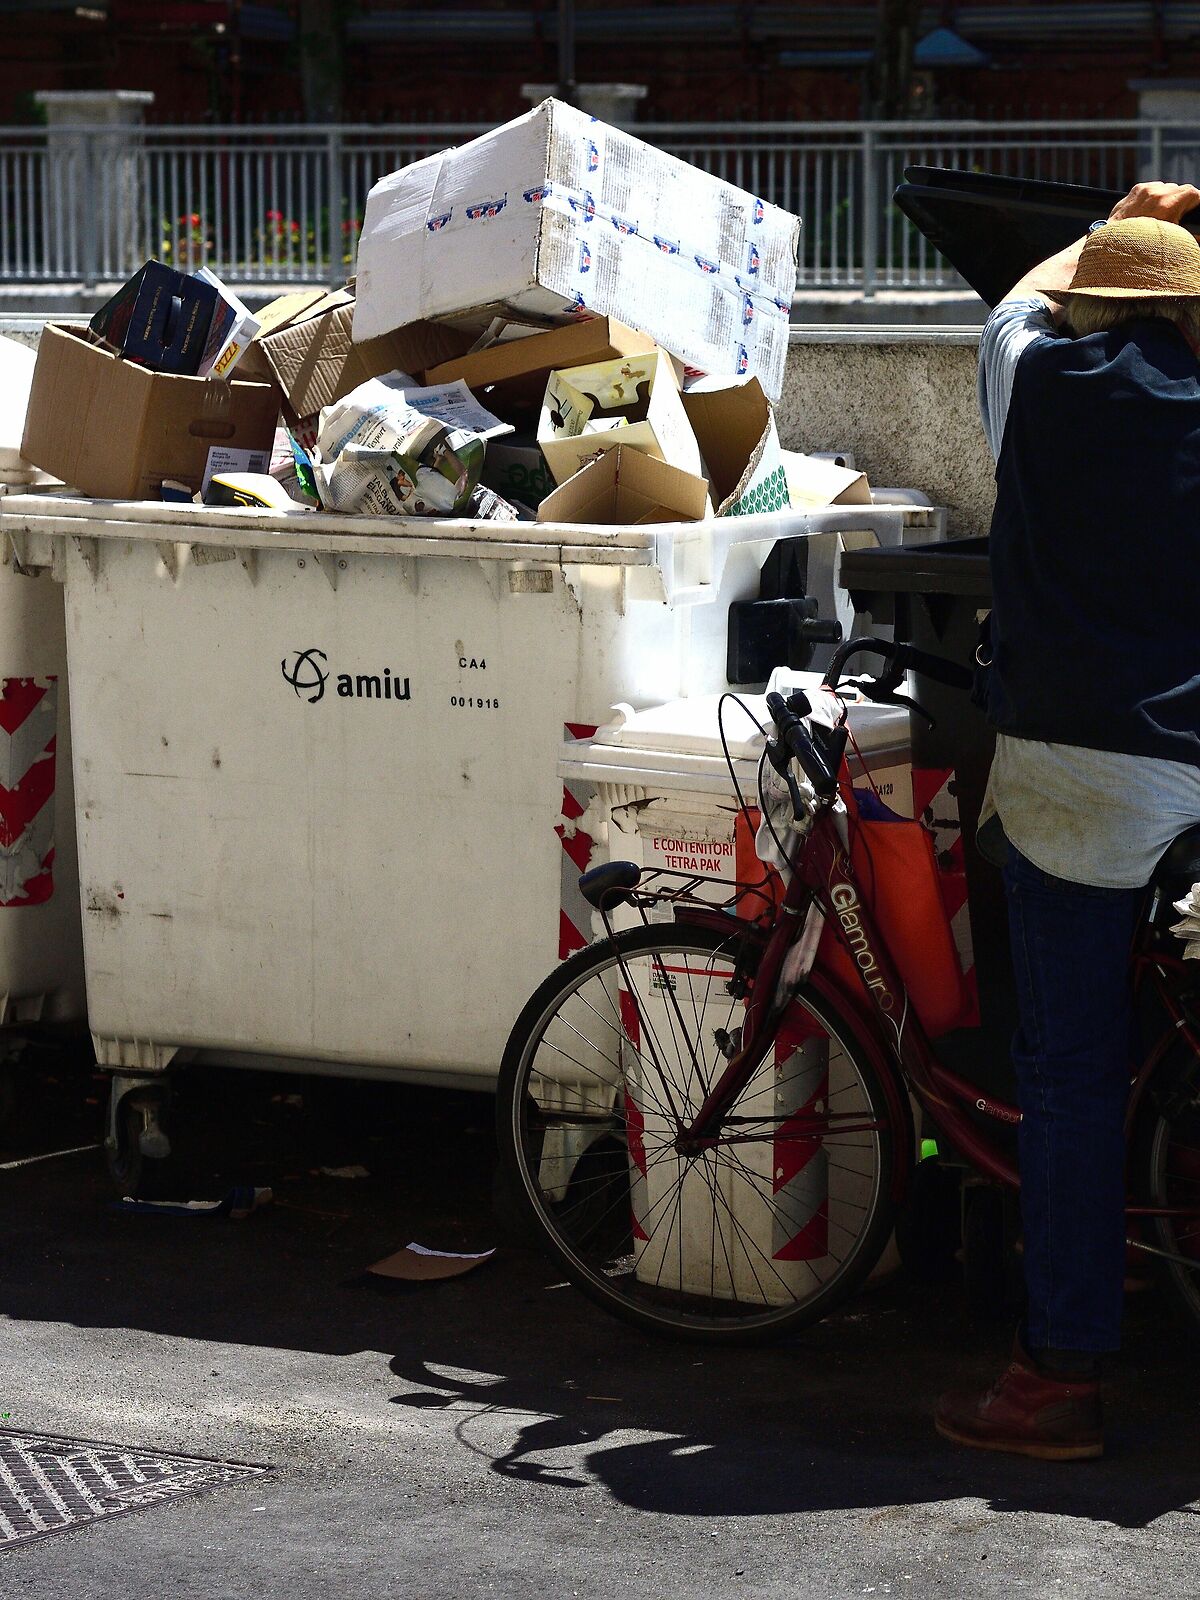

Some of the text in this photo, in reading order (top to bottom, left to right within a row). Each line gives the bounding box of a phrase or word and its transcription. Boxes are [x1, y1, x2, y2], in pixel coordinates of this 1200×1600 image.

[214, 341, 240, 374] PIZZA
[459, 657, 486, 669] CA4
[337, 667, 411, 701] amiu
[653, 838, 733, 856] E CONTENITORI
[665, 855, 721, 872] TETRA PAK
[831, 883, 886, 991] Glamour
